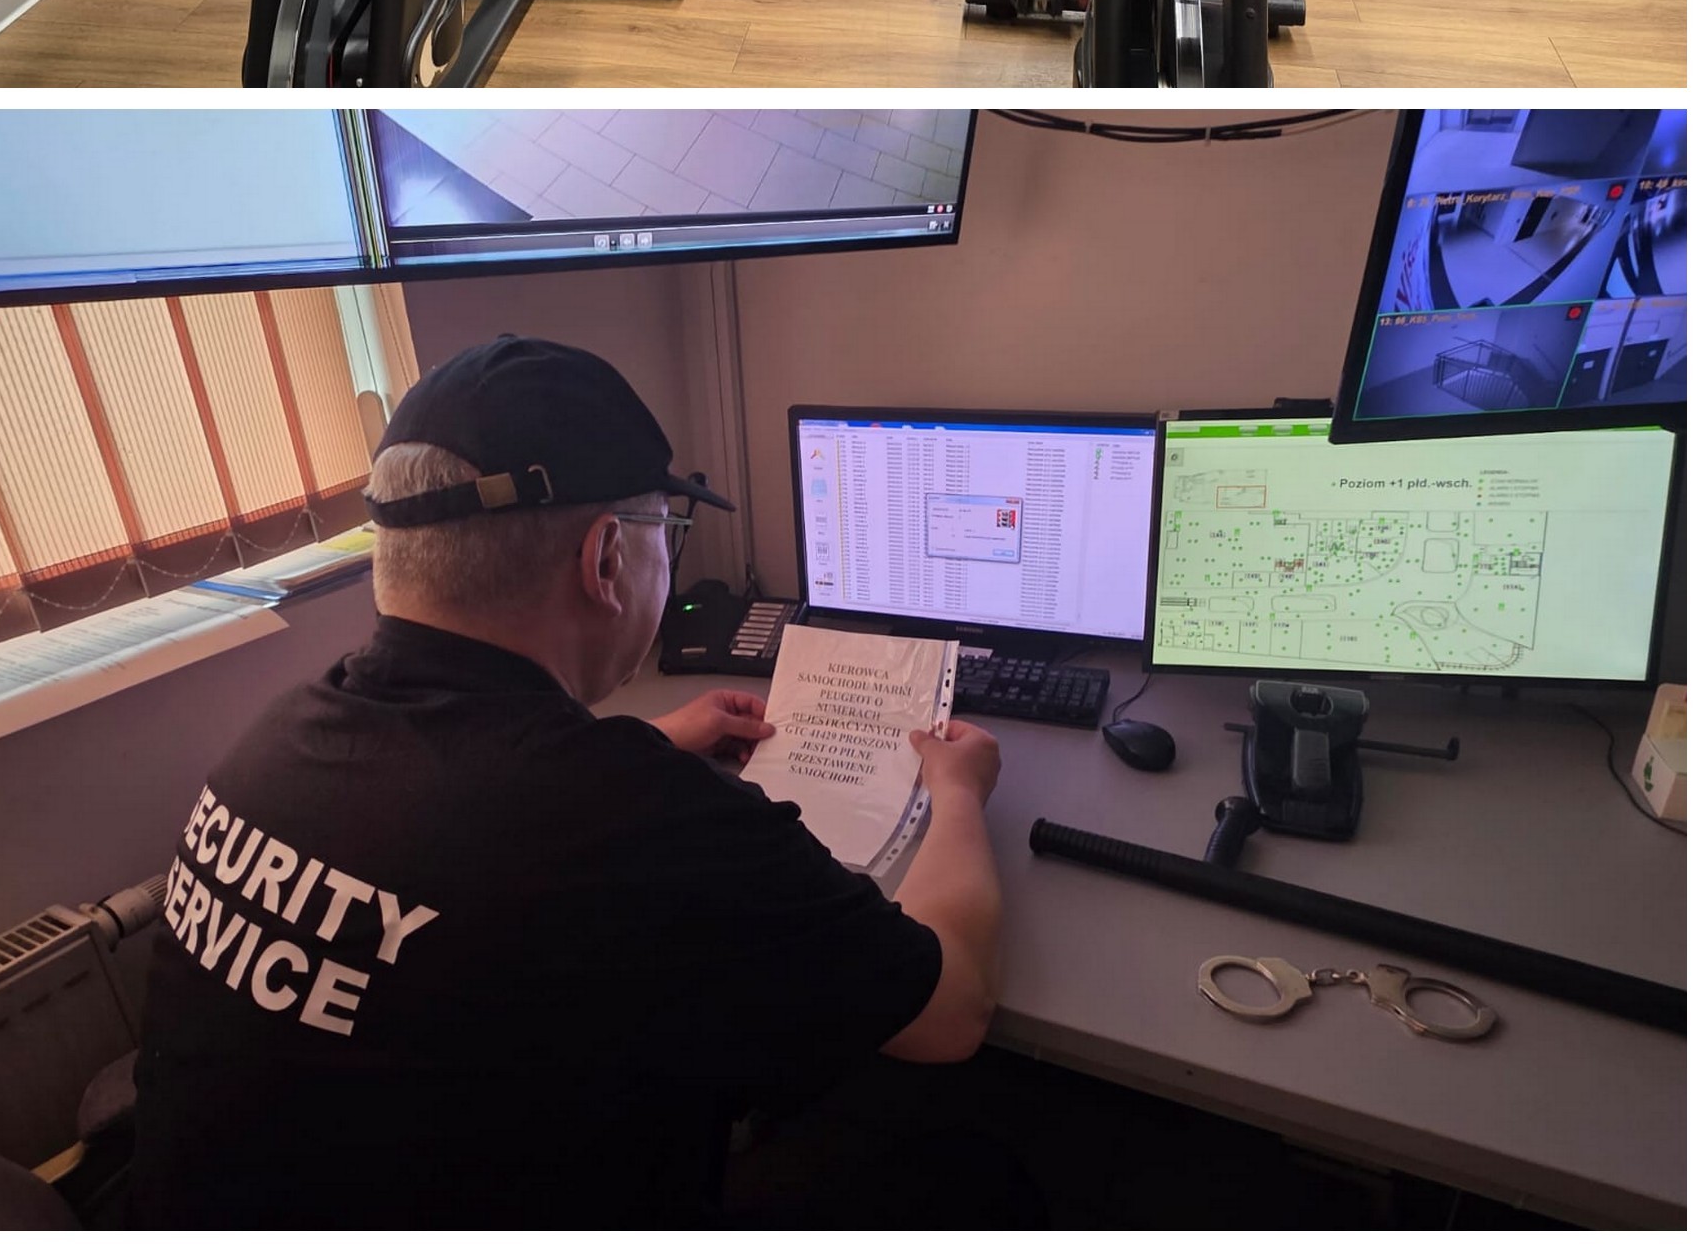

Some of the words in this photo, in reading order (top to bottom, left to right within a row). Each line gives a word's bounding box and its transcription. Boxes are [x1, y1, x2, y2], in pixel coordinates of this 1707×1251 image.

[1339, 478, 1385, 489] Poziom
[1390, 478, 1403, 488] +1
[827, 662, 889, 680] KIEROWCA
[797, 672, 869, 690] SAMOCHODU
[873, 682, 912, 697] MARKI
[820, 688, 872, 705] PEUGEOT
[874, 696, 884, 707] O
[816, 702, 881, 721] NUMERACH
[791, 712, 901, 738] REJESTRACYJNYCH
[800, 741, 826, 753] JEST
[828, 745, 838, 755] O
[839, 747, 874, 761] PILNE
[839, 732, 901, 751] PROSZONY
[788, 751, 877, 775] PRZESTAWIENIE
[788, 764, 865, 786] SAMOCHODU.
[163, 855, 371, 1037] SERVICE
